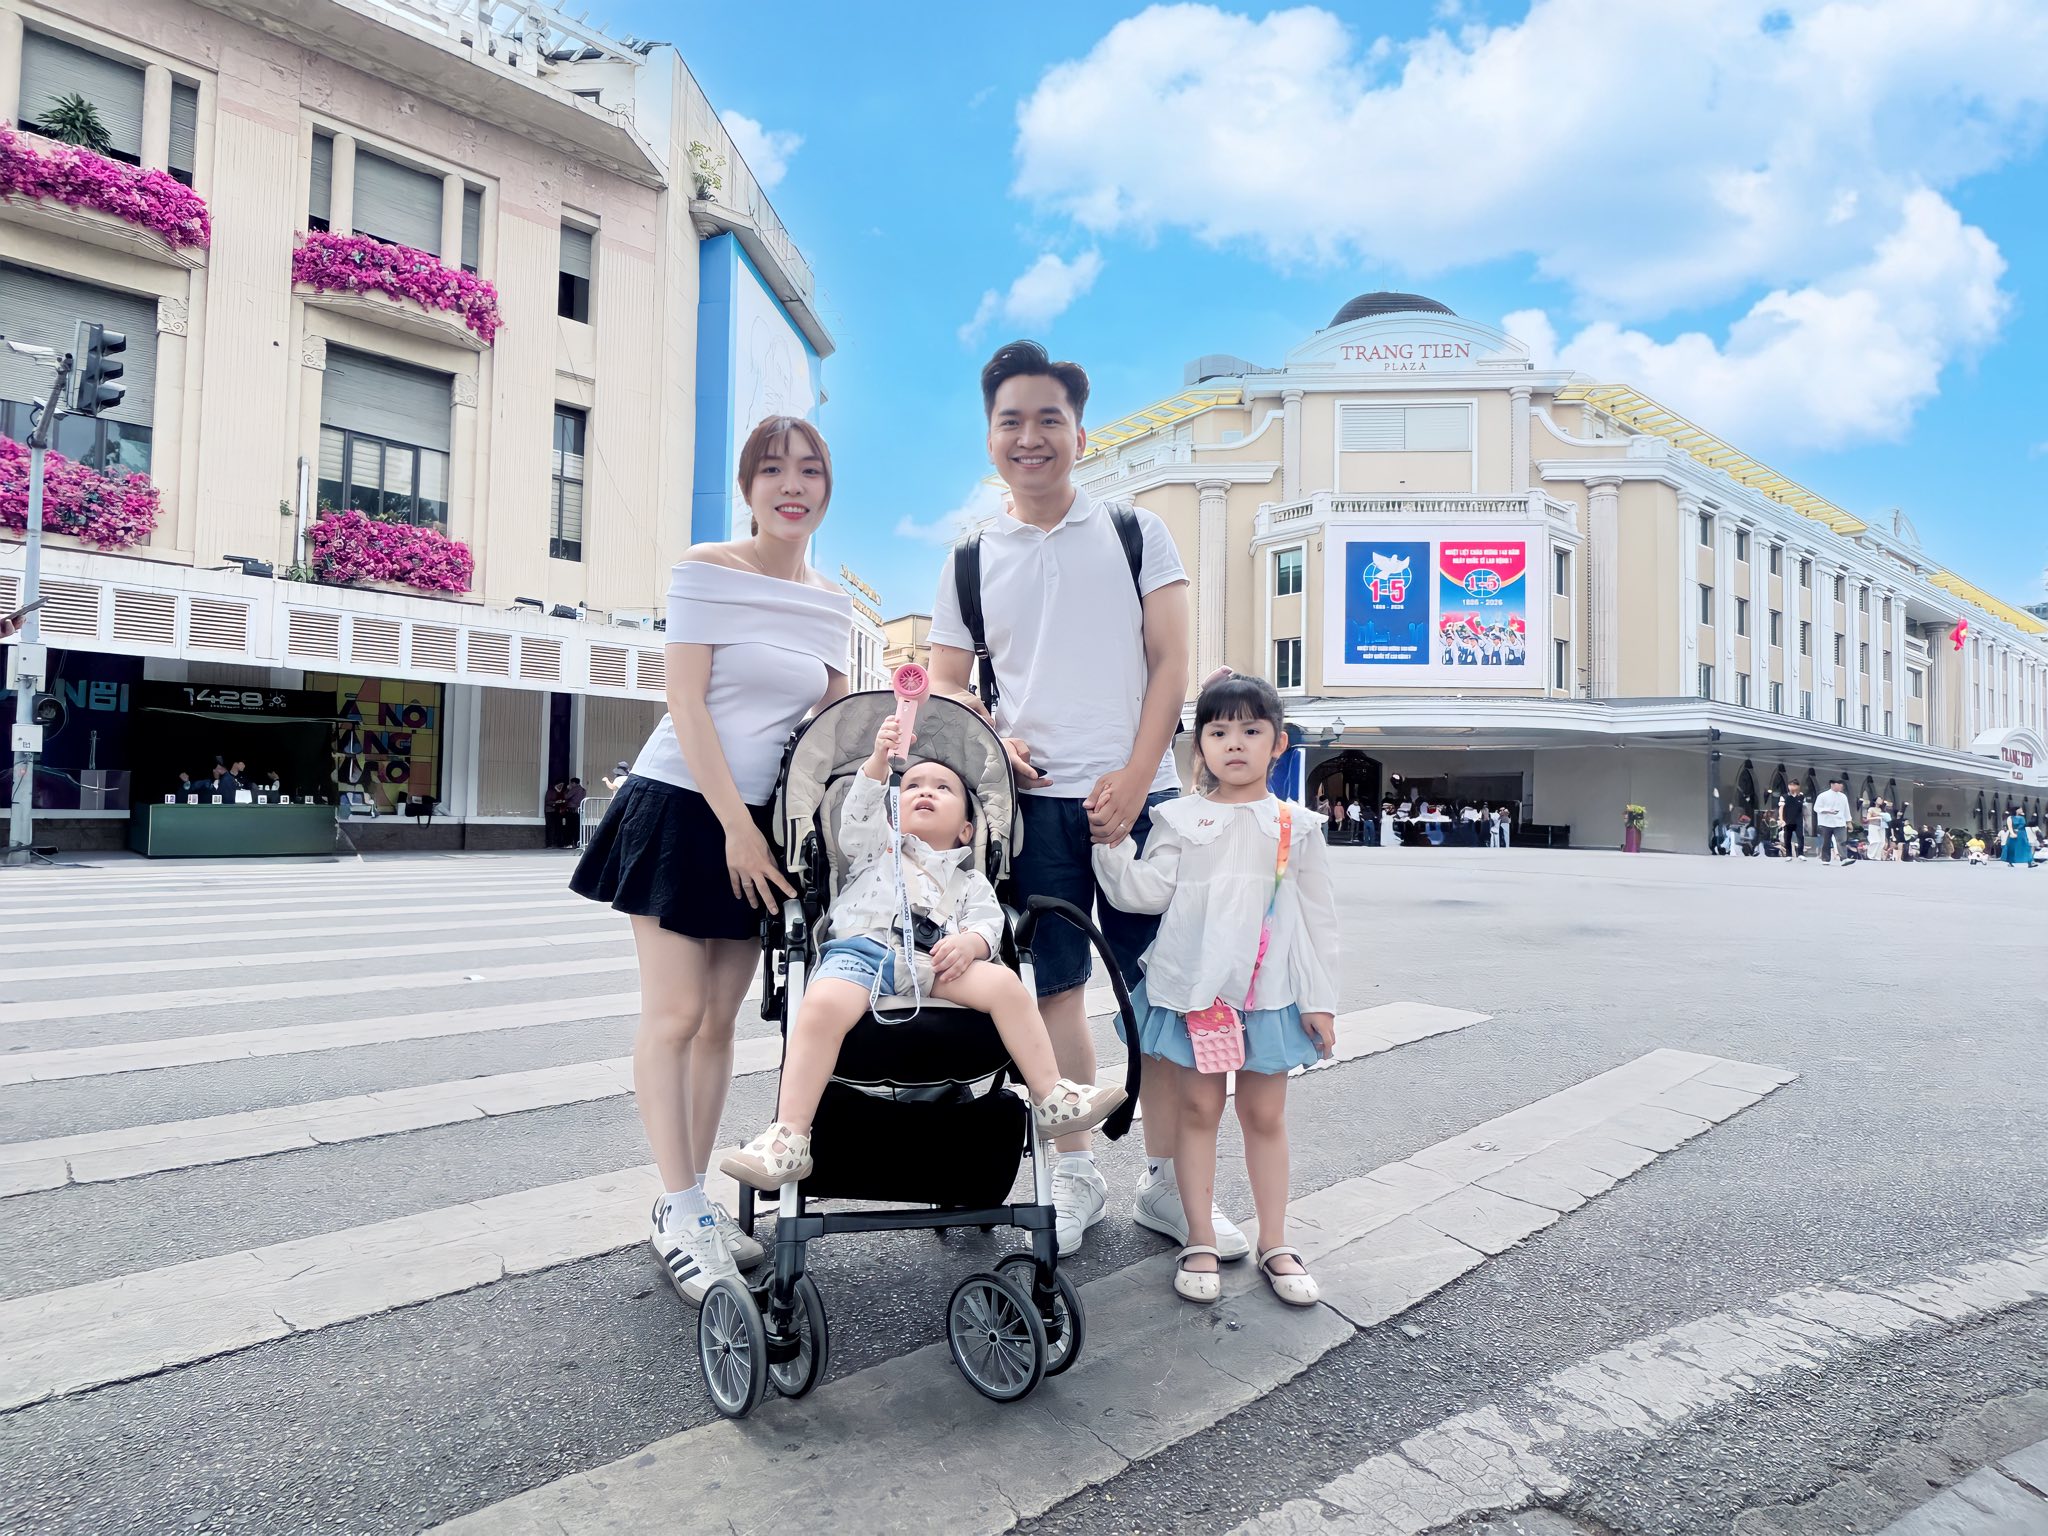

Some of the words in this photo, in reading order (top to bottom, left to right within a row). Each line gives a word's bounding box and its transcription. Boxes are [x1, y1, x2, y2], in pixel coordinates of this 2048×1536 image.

[1340, 344, 1413, 362] TRANG
[1418, 343, 1471, 359] TIEN
[1384, 362, 1427, 371] PLAZA
[184, 687, 264, 707] 1428
